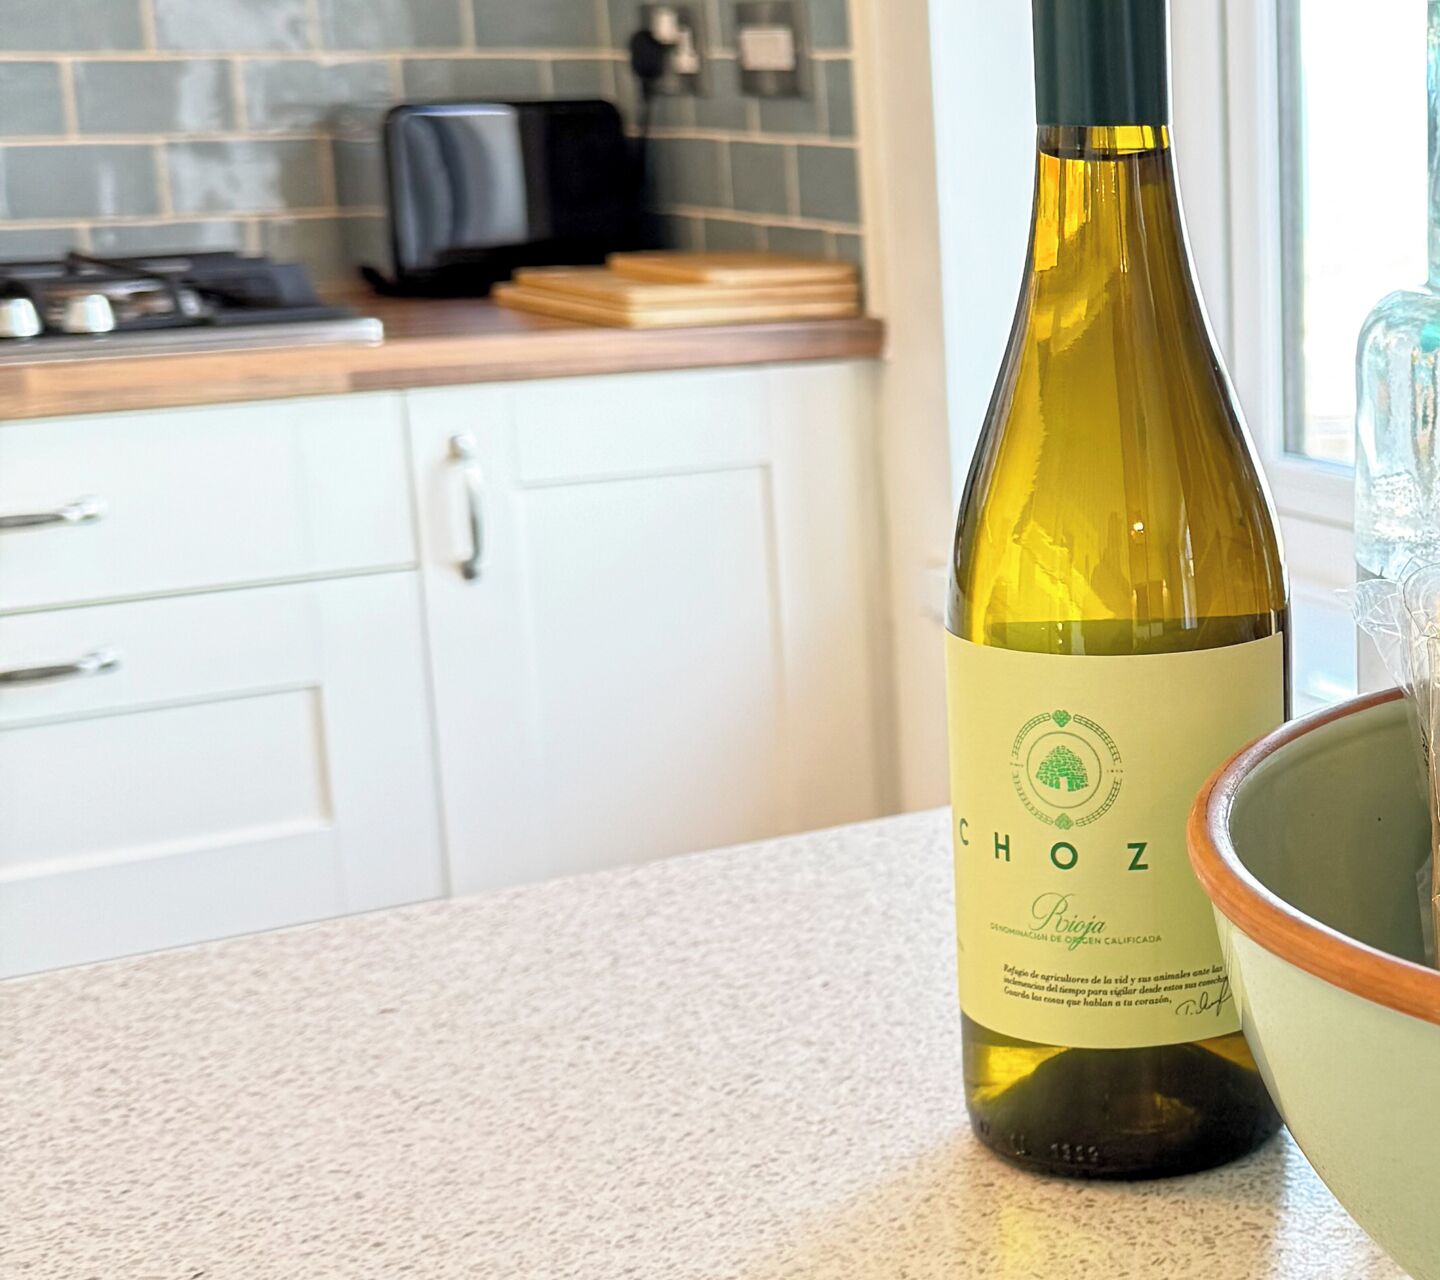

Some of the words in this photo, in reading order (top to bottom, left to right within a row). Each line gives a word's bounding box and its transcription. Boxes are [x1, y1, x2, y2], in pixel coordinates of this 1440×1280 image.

[1029, 892, 1106, 951] Rioja
[1104, 936, 1162, 945] CALIFICADA
[1030, 970, 1039, 978] de
[1041, 973, 1089, 984] agricultores
[1091, 976, 1101, 984] de
[1103, 976, 1112, 984] la
[1115, 975, 1129, 984] vid
[1130, 977, 1137, 985] y
[1153, 970, 1191, 981] animales
[1192, 968, 1210, 976] ante
[1212, 965, 1223, 973] las
[1046, 983, 1058, 992] del
[1059, 985, 1085, 997] tiempo
[1087, 988, 1108, 997] para
[1110, 985, 1136, 997] vigilar
[1139, 984, 1160, 994] desde
[1163, 983, 1183, 991] estos
[1032, 992, 1042, 1001] las
[1043, 996, 1064, 1004] cosas
[1066, 999, 1081, 1007] que
[1083, 998, 1113, 1007] hablan
